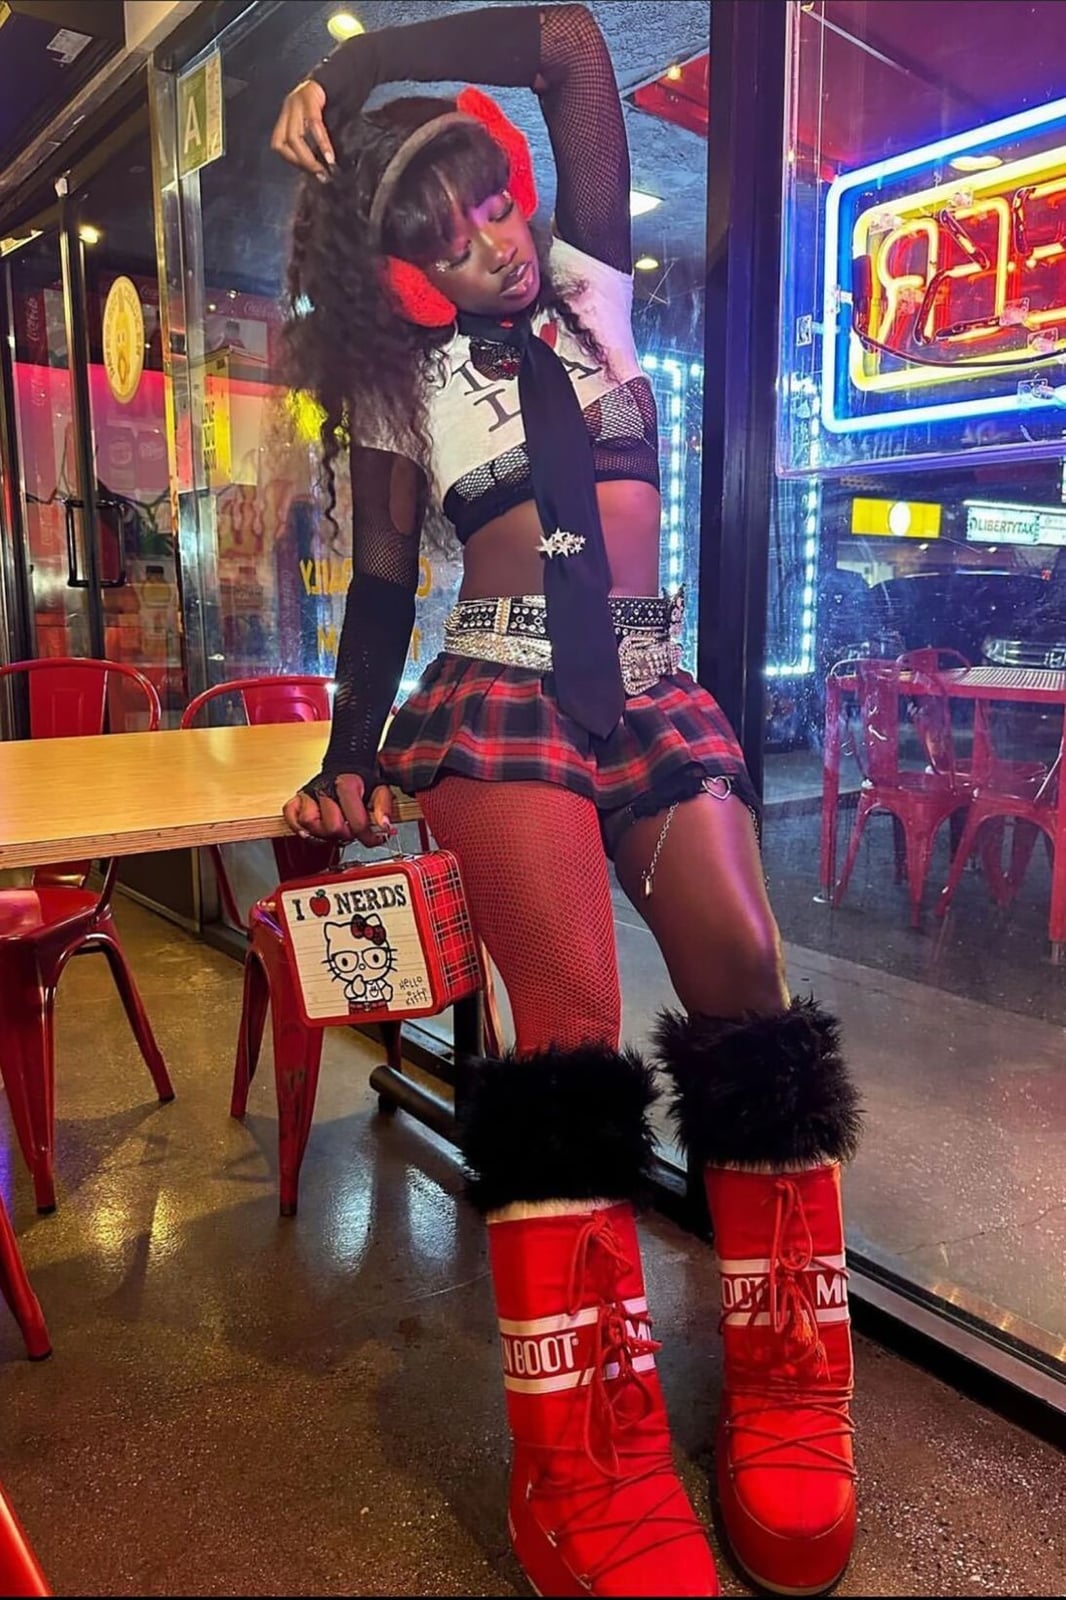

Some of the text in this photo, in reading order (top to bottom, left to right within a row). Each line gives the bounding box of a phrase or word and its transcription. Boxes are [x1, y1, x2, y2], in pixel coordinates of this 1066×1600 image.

[184, 96, 202, 154] A
[292, 886, 407, 921] I NERDS
